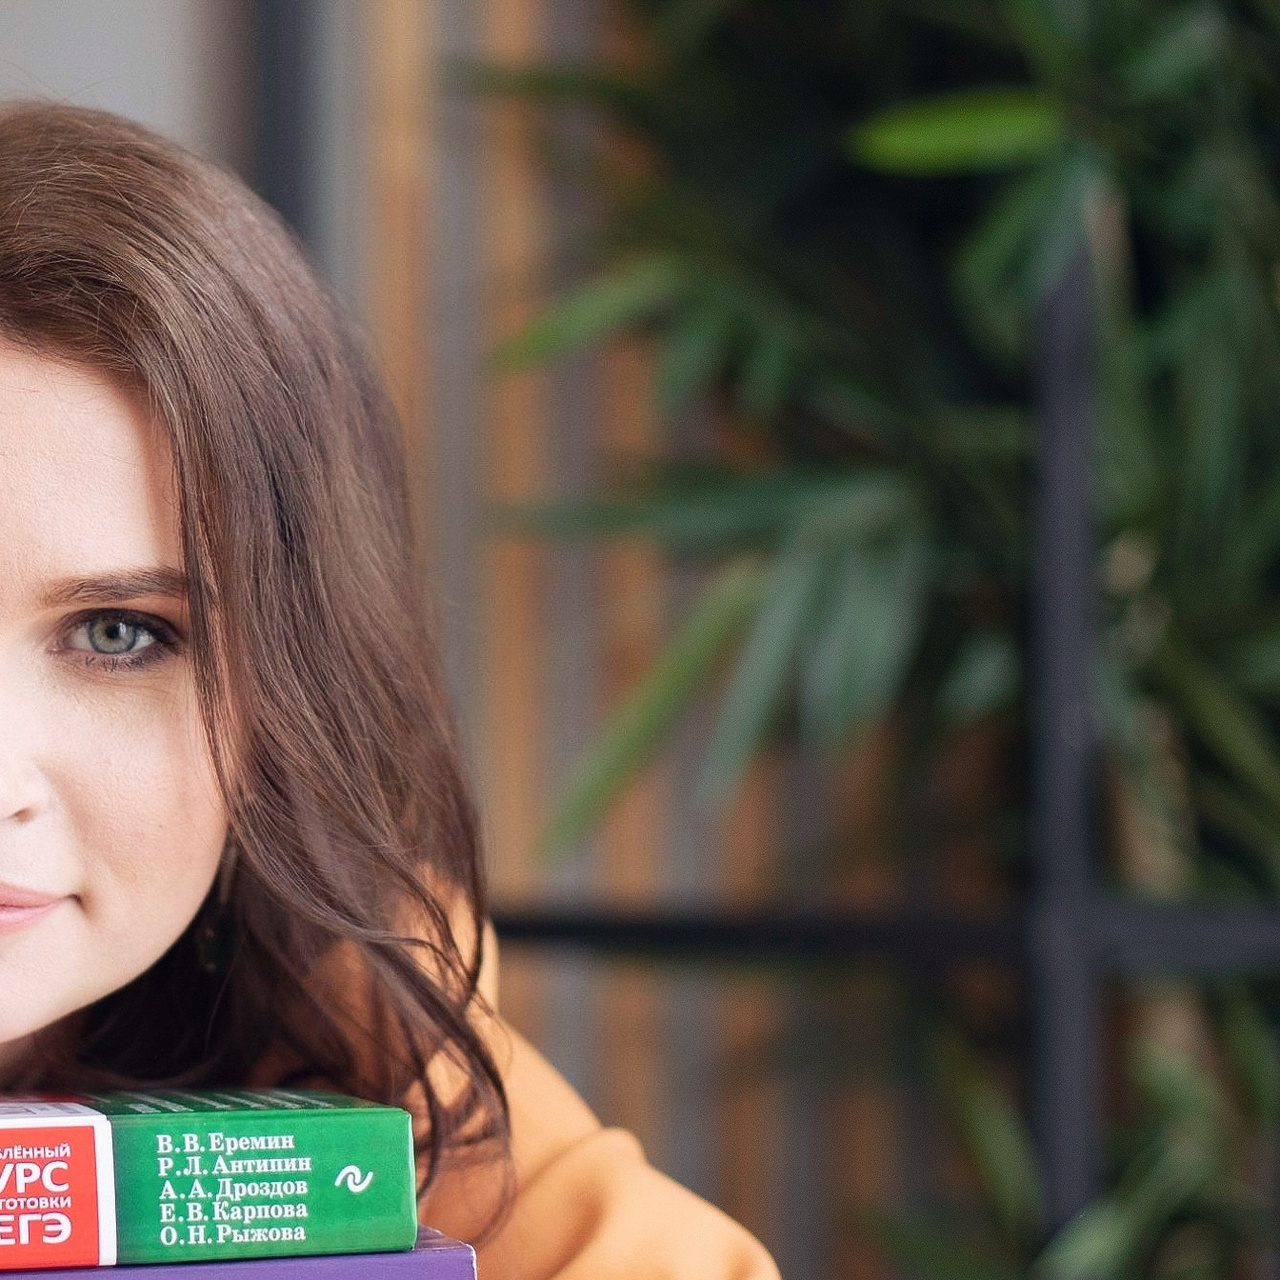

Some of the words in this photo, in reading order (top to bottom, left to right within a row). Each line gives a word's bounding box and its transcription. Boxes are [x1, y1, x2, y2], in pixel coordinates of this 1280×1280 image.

[208, 1132, 294, 1155] Еремин
[211, 1154, 312, 1174] Антипин
[215, 1177, 308, 1201] Дроздов
[212, 1201, 308, 1224] Карпова
[216, 1224, 306, 1244] Рыжова
